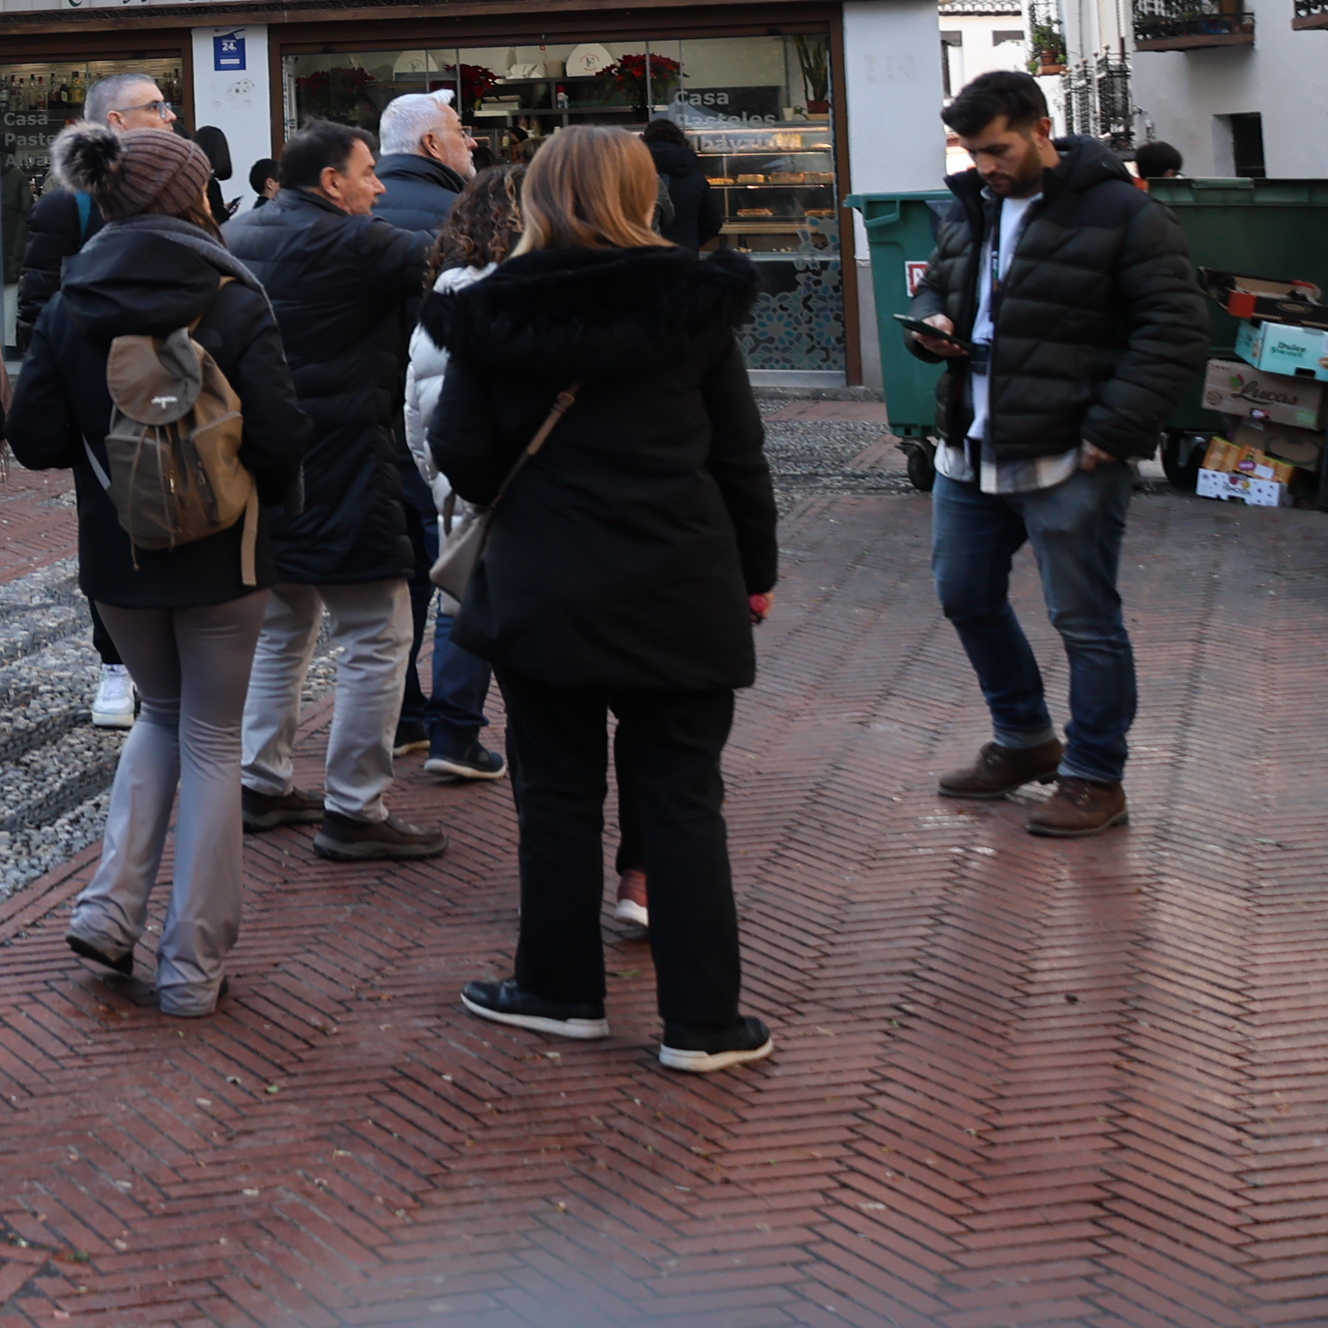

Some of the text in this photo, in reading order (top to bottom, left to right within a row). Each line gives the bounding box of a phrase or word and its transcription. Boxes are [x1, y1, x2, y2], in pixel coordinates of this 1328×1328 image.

[675, 90, 729, 105] Casa
[4, 112, 48, 126] Casa
[4, 132, 55, 147] Paste
